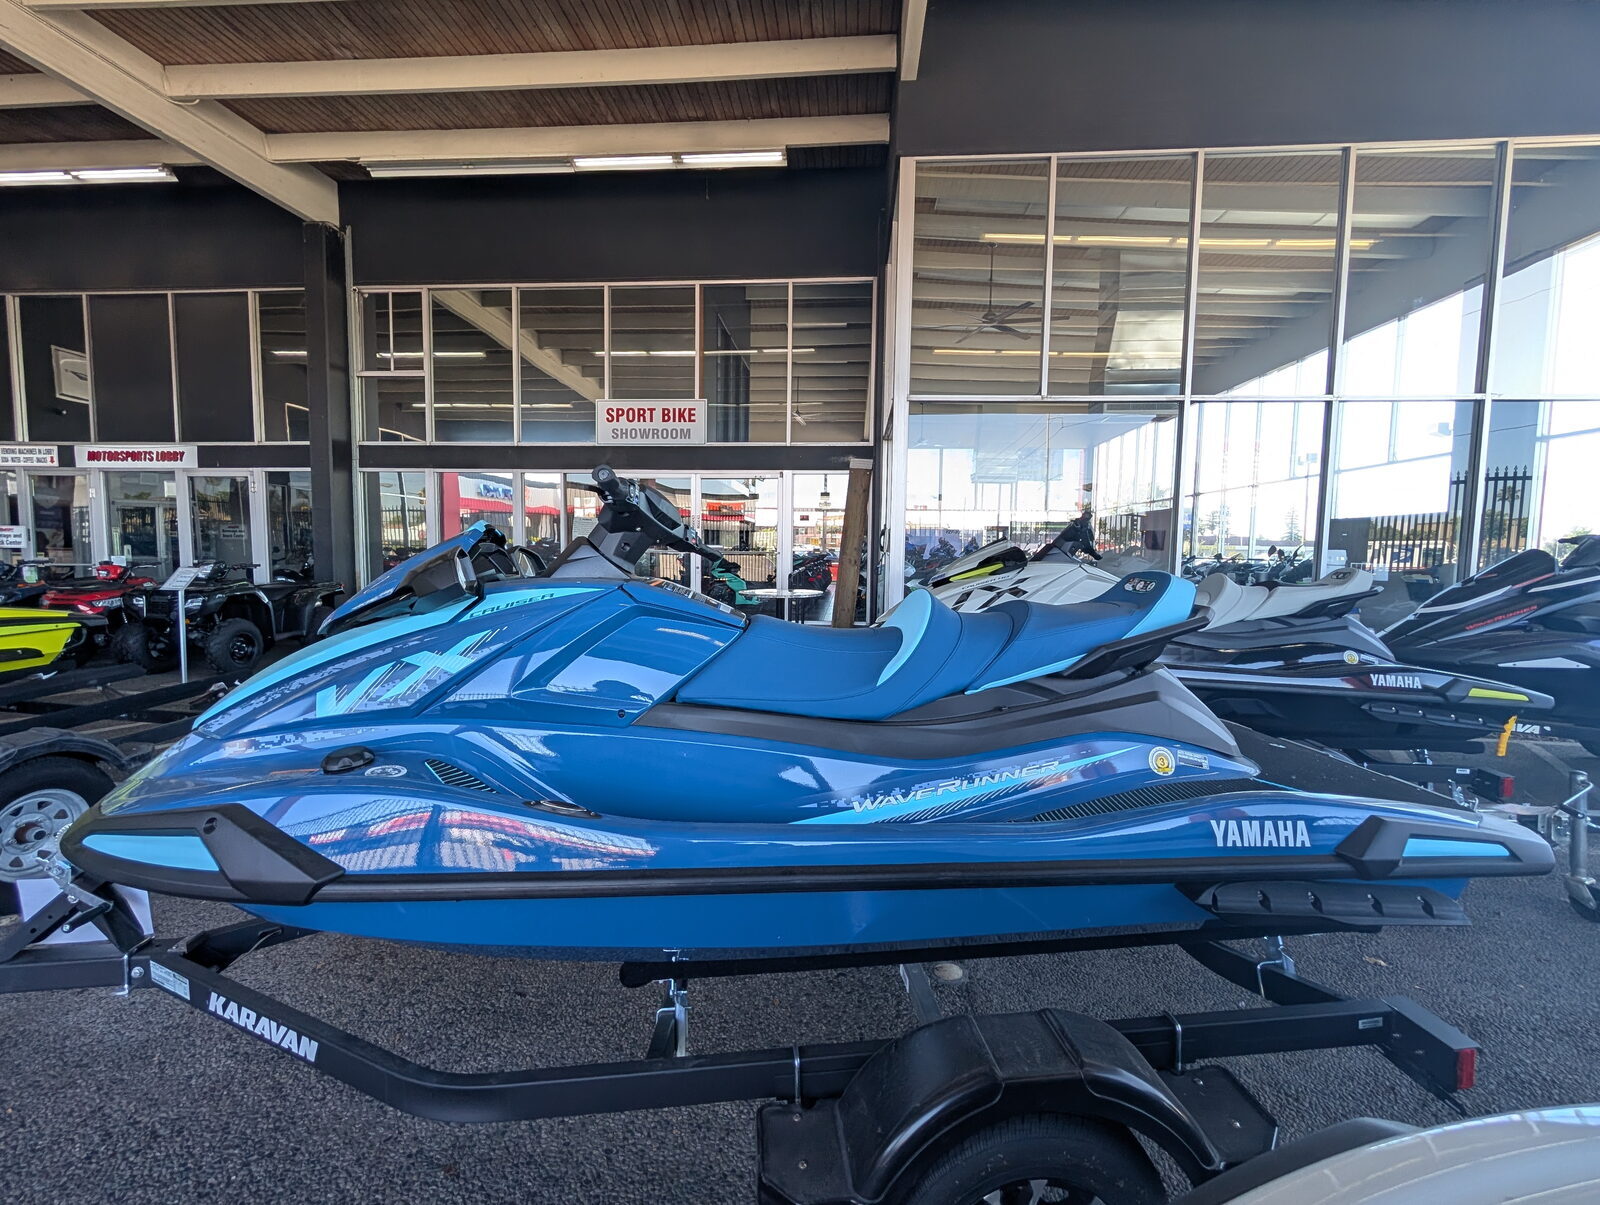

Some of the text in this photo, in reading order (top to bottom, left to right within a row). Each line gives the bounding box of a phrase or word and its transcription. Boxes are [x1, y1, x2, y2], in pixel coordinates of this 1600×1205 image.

[606, 407, 697, 423] SPORT BIKE
[611, 428, 691, 440] SHOWROOM
[87, 450, 185, 462] MOTORSPORTS LOBBY
[469, 593, 555, 618] CRUISER
[1370, 673, 1422, 689] YAMAHA
[852, 760, 1060, 813] WAVERUNNER
[1210, 819, 1311, 847] YAMAHA
[208, 991, 319, 1063] KARAVAN
